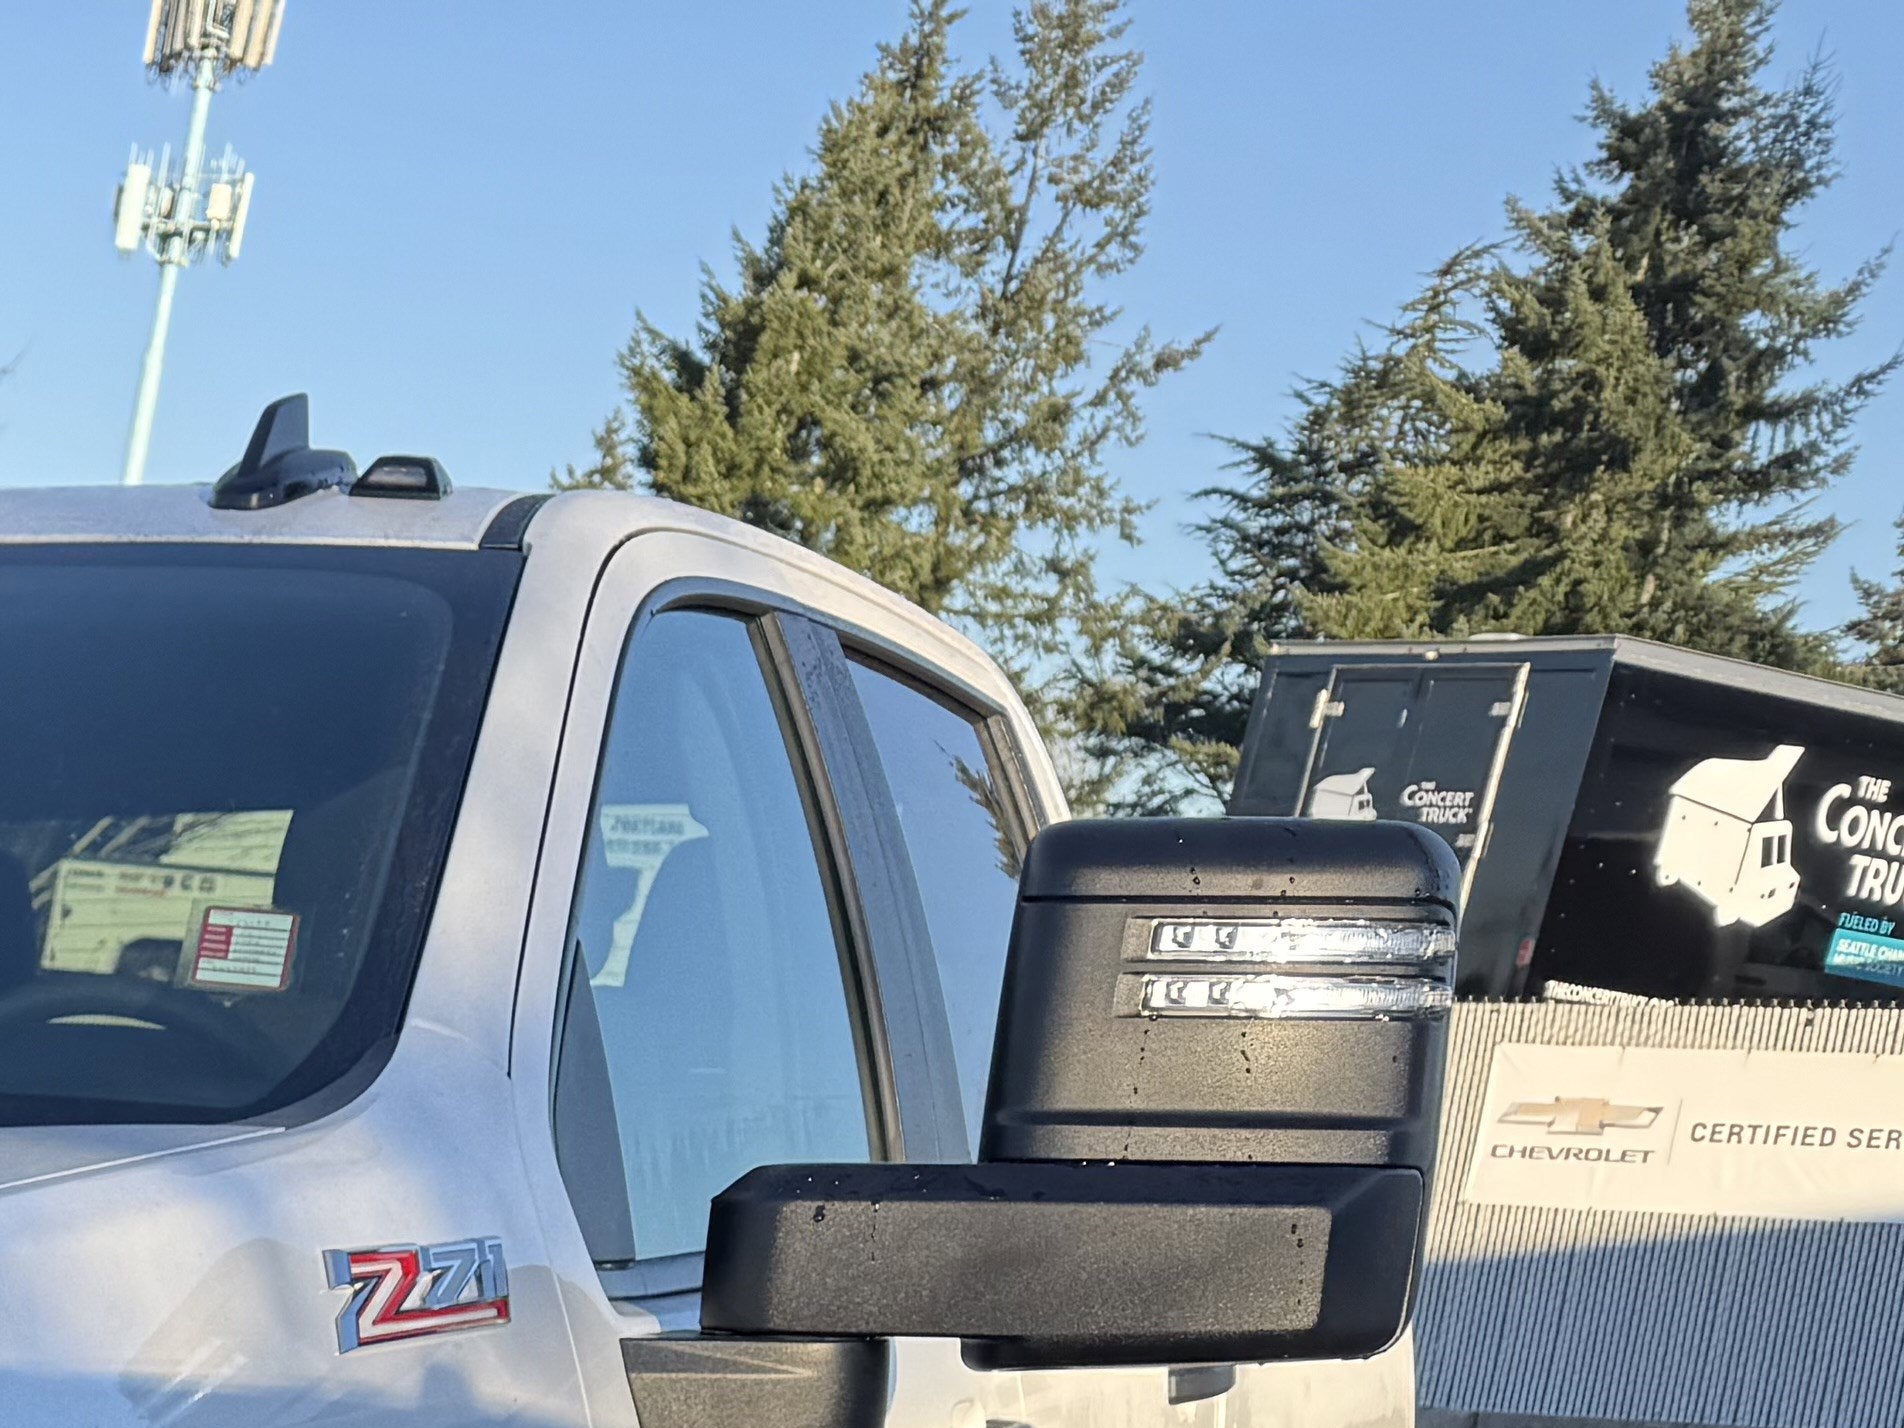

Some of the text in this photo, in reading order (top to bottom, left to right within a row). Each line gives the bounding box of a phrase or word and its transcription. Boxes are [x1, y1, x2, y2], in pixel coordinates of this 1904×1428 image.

[1400, 784, 1474, 807] CONCERT
[1857, 775, 1891, 803] THE
[1420, 807, 1469, 824] TRUCK
[1838, 911, 1896, 935] FUELED BY
[1691, 1122, 1837, 1147] CERTIFIED
[1490, 1143, 1655, 1164] CHEVROLET
[322, 1236, 511, 1355] Z71
